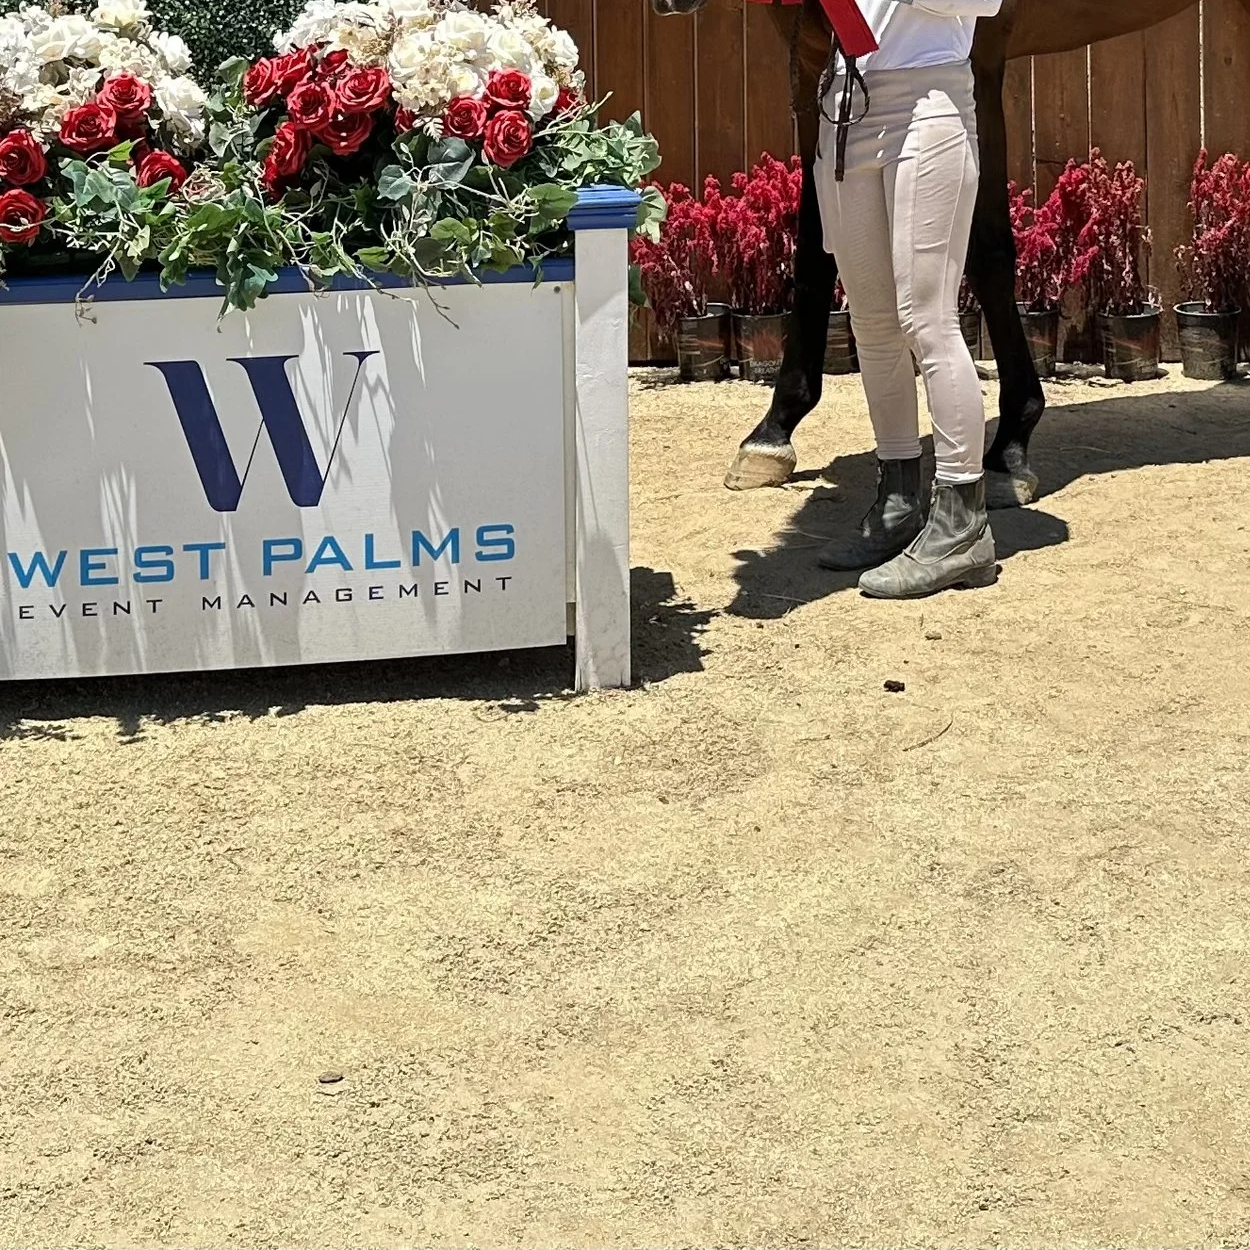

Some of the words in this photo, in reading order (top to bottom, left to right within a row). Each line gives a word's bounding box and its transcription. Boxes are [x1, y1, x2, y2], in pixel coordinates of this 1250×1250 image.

[144, 351, 380, 513] W
[8, 533, 225, 589] WEST
[262, 524, 516, 576] PALMS
[18, 599, 163, 620] EVENT
[202, 576, 513, 611] MANAGEMENT
